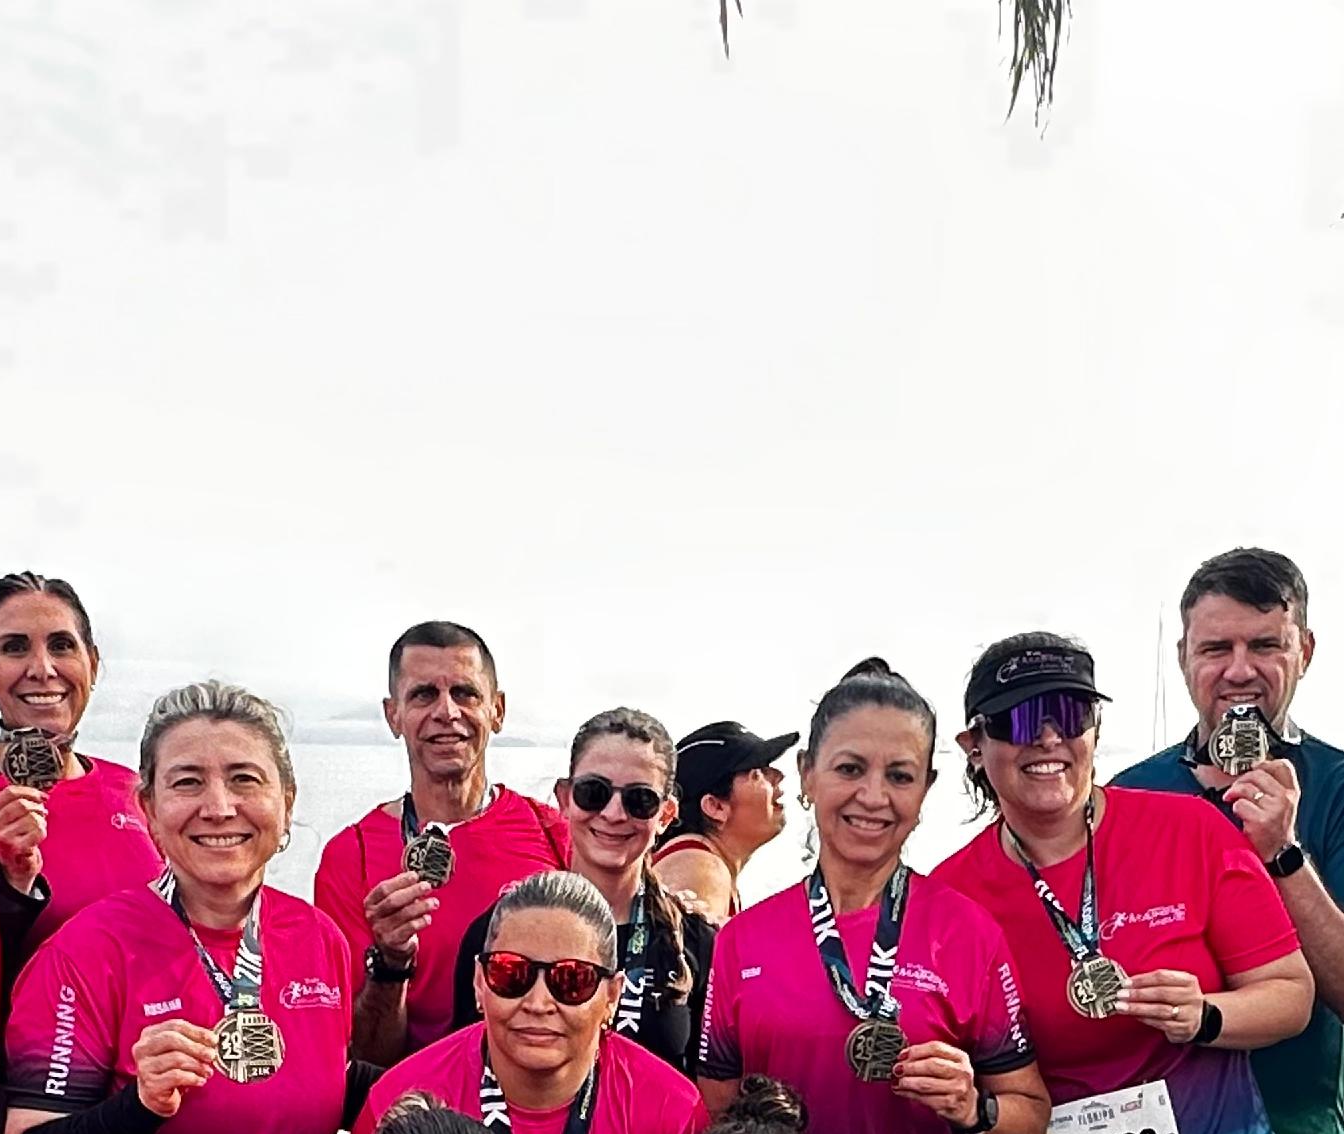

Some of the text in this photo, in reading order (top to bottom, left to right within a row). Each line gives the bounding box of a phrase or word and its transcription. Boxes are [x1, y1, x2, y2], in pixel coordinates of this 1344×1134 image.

[809, 885, 840, 946] 21K
[865, 941, 898, 1000] 21K
[1075, 979, 1093, 994] 20
[616, 973, 646, 1033] 21K
[45, 984, 76, 1096] RUNNING
[220, 1031, 240, 1046] 20
[222, 1044, 243, 1060] 25
[250, 1066, 271, 1077] 21K
